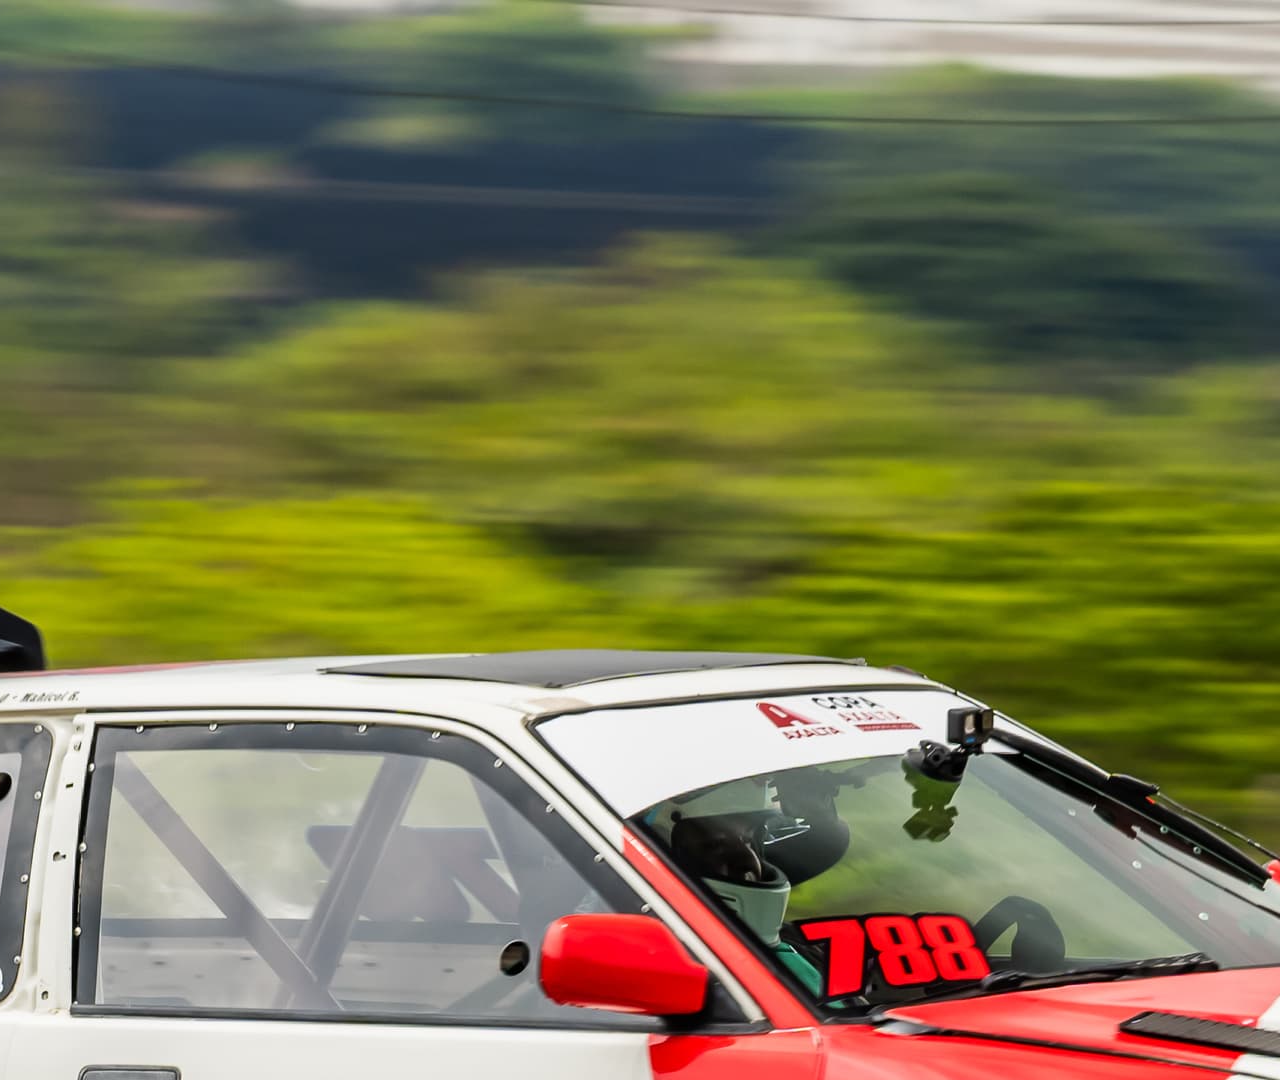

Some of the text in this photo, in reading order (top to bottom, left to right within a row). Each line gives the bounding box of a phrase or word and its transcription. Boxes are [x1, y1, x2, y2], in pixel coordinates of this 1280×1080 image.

[811, 696, 885, 709] COPA
[781, 725, 847, 740] AXALTA
[797, 913, 993, 998] 788
